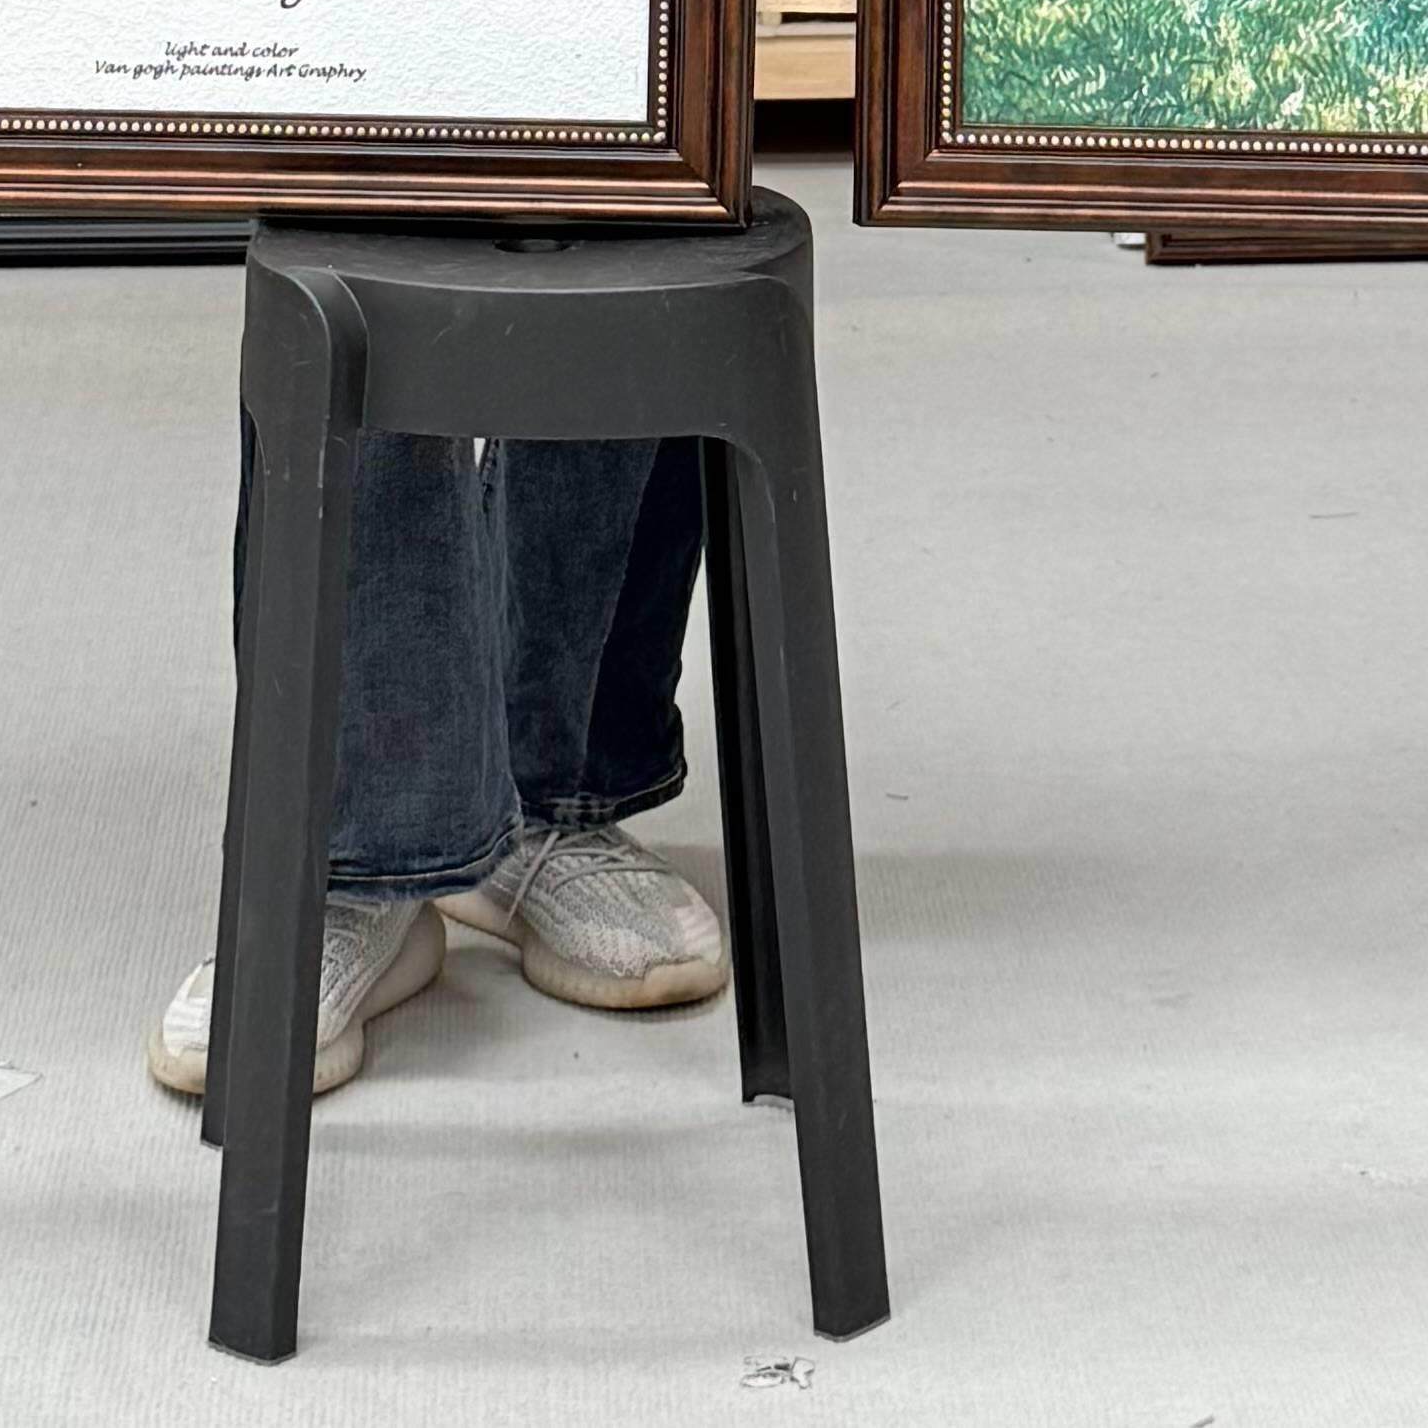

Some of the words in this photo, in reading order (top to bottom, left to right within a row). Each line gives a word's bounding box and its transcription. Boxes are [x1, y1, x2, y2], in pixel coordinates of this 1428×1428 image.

[165, 41, 209, 61] light
[211, 43, 250, 57] and
[252, 43, 299, 58] color
[94, 60, 131, 75] Van
[132, 59, 178, 80] gogh
[266, 63, 296, 78] Art
